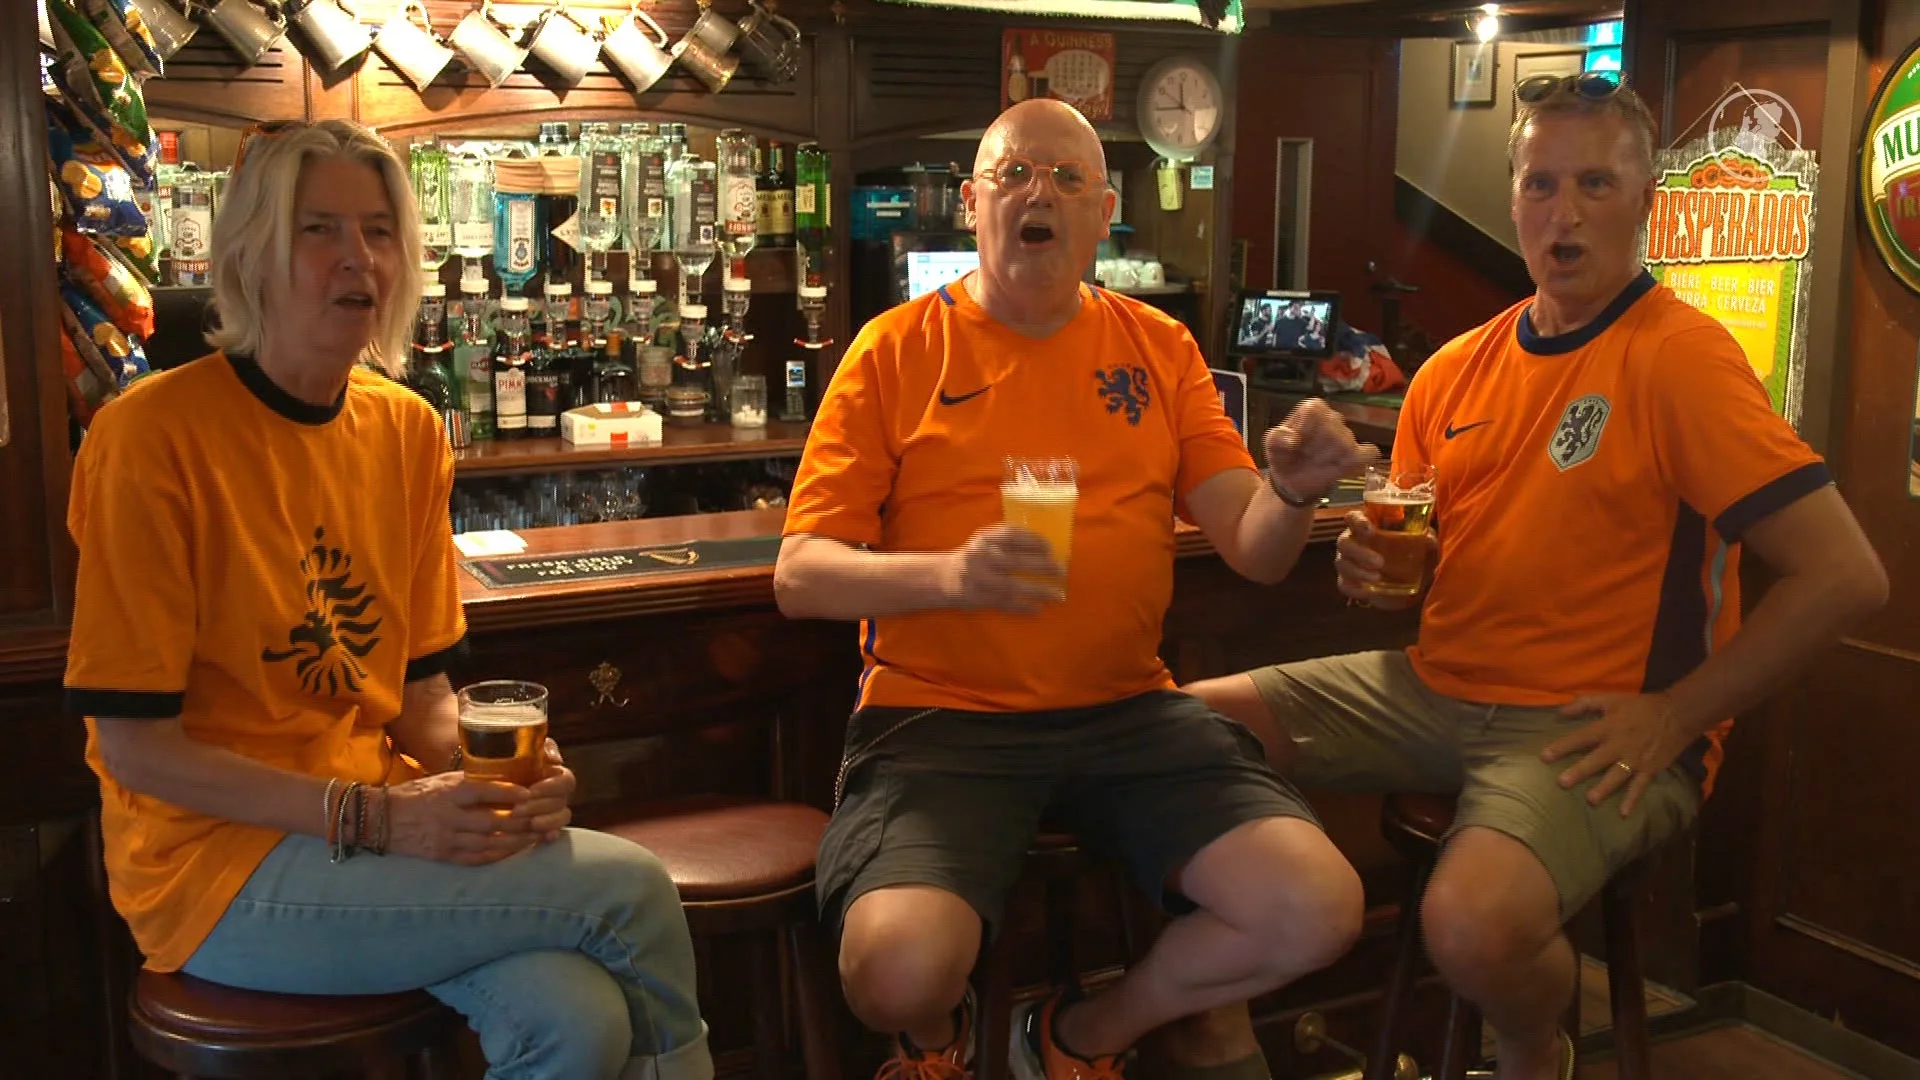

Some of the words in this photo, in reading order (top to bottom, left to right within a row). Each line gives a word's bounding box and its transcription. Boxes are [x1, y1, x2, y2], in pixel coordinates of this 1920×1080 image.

[1030, 32, 1039, 46] A
[1045, 31, 1112, 48] GUINNESS
[1647, 190, 1810, 260] DESPERADOS
[1711, 275, 1738, 293] BEER
[1748, 279, 1775, 296] BIER
[1717, 295, 1766, 314] CERVEZA
